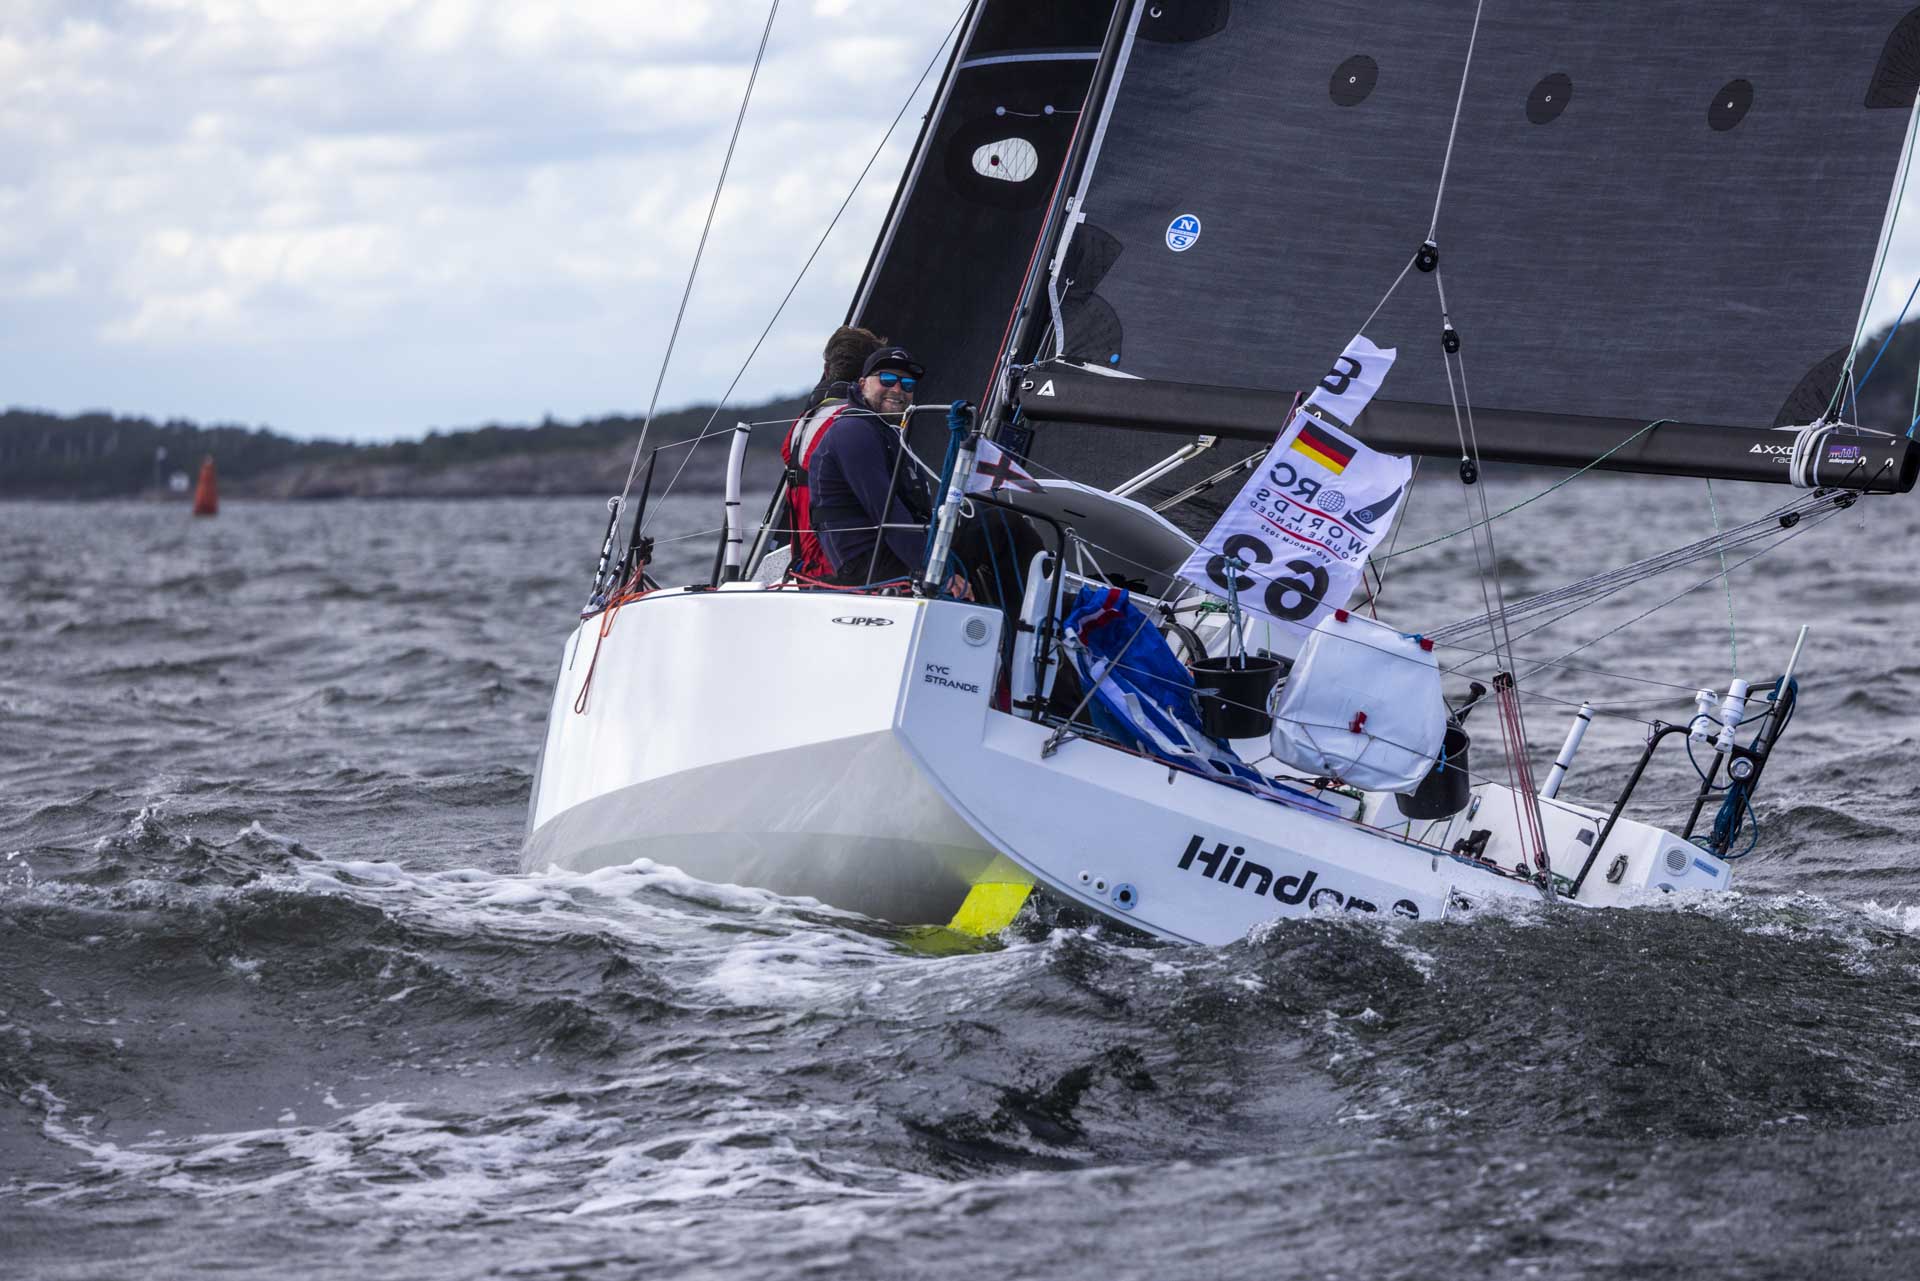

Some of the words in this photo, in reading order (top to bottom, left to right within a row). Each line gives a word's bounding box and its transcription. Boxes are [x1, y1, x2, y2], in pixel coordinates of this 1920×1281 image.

[1178, 219, 1196, 231] N
[1173, 235, 1187, 246] S
[926, 663, 951, 676] KYC
[924, 674, 980, 694] STRANDE
